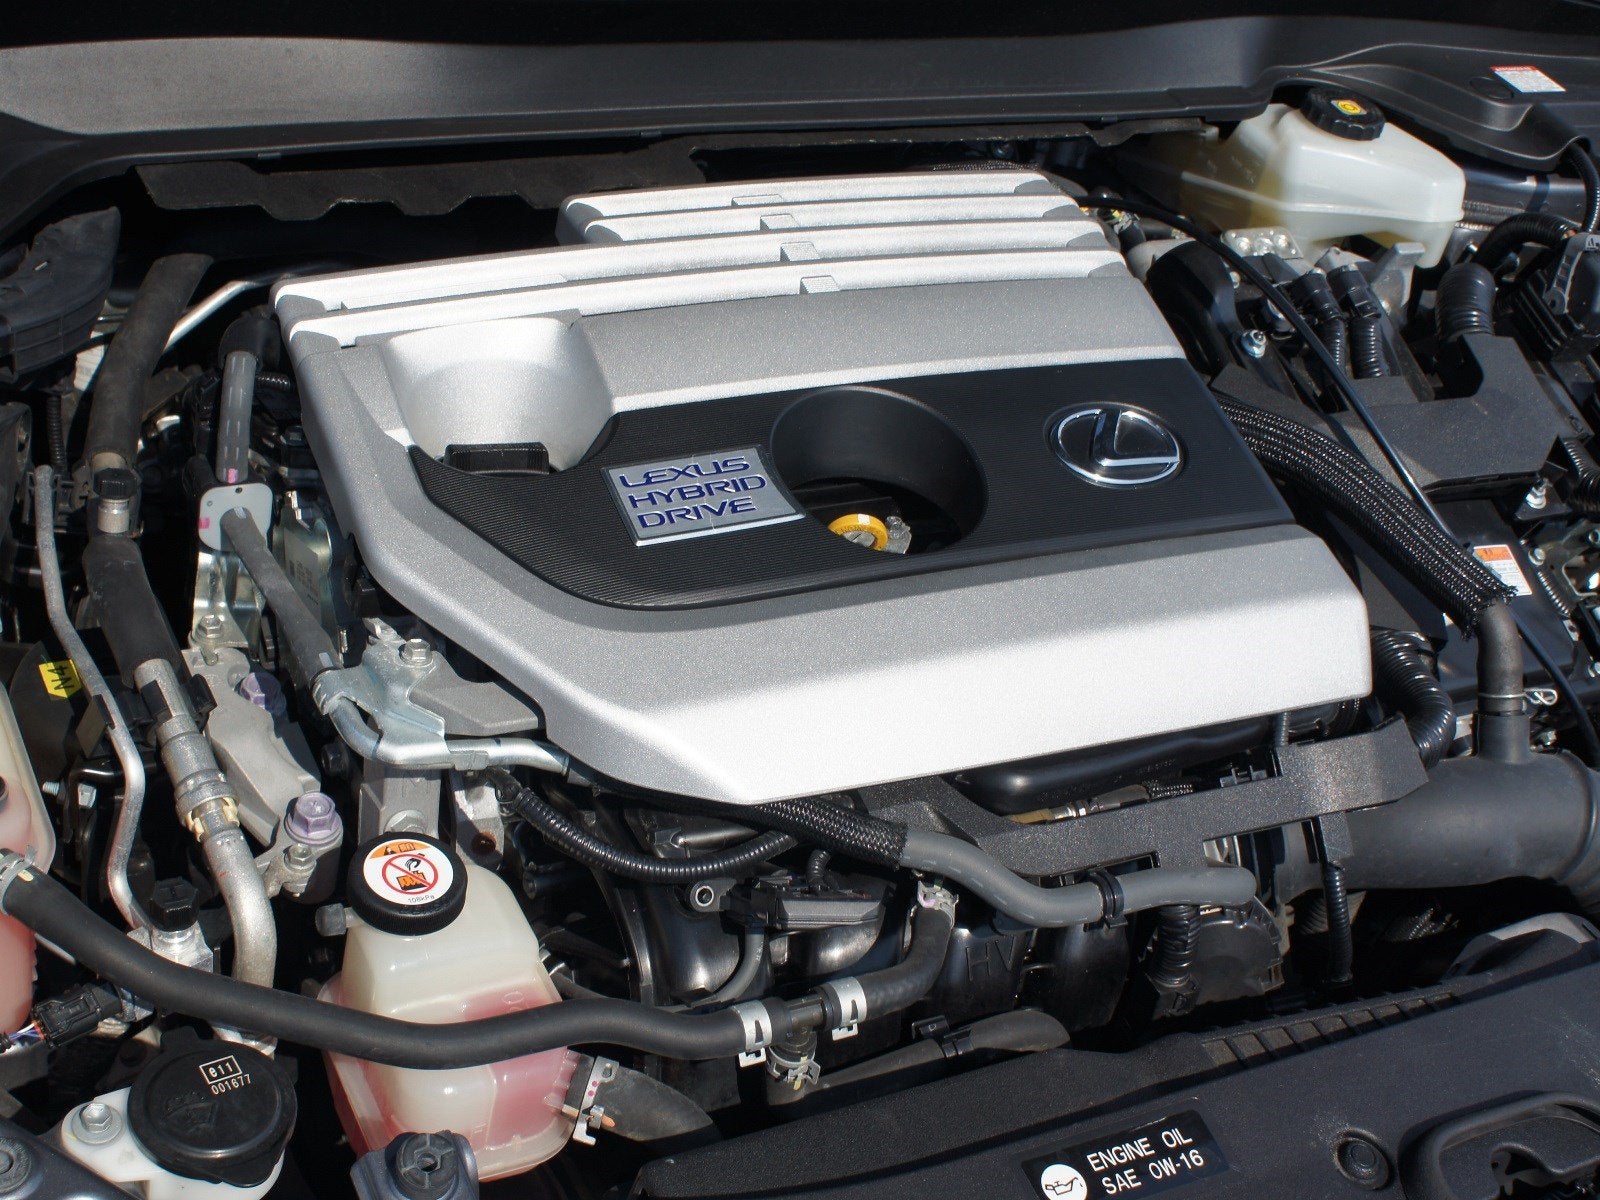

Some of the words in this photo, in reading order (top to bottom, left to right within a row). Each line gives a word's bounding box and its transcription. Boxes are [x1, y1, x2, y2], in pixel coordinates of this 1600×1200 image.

[619, 456, 751, 488] LEXUS
[627, 474, 767, 508] HYBRID
[637, 496, 758, 529] DRIVE
[208, 1062, 233, 1078] e11
[211, 1073, 251, 1095] 001677
[1086, 1137, 1156, 1173] ENGINE
[1161, 1127, 1193, 1149] OIL
[1101, 1168, 1142, 1195] SAE
[1148, 1149, 1204, 1180] 0W-16
